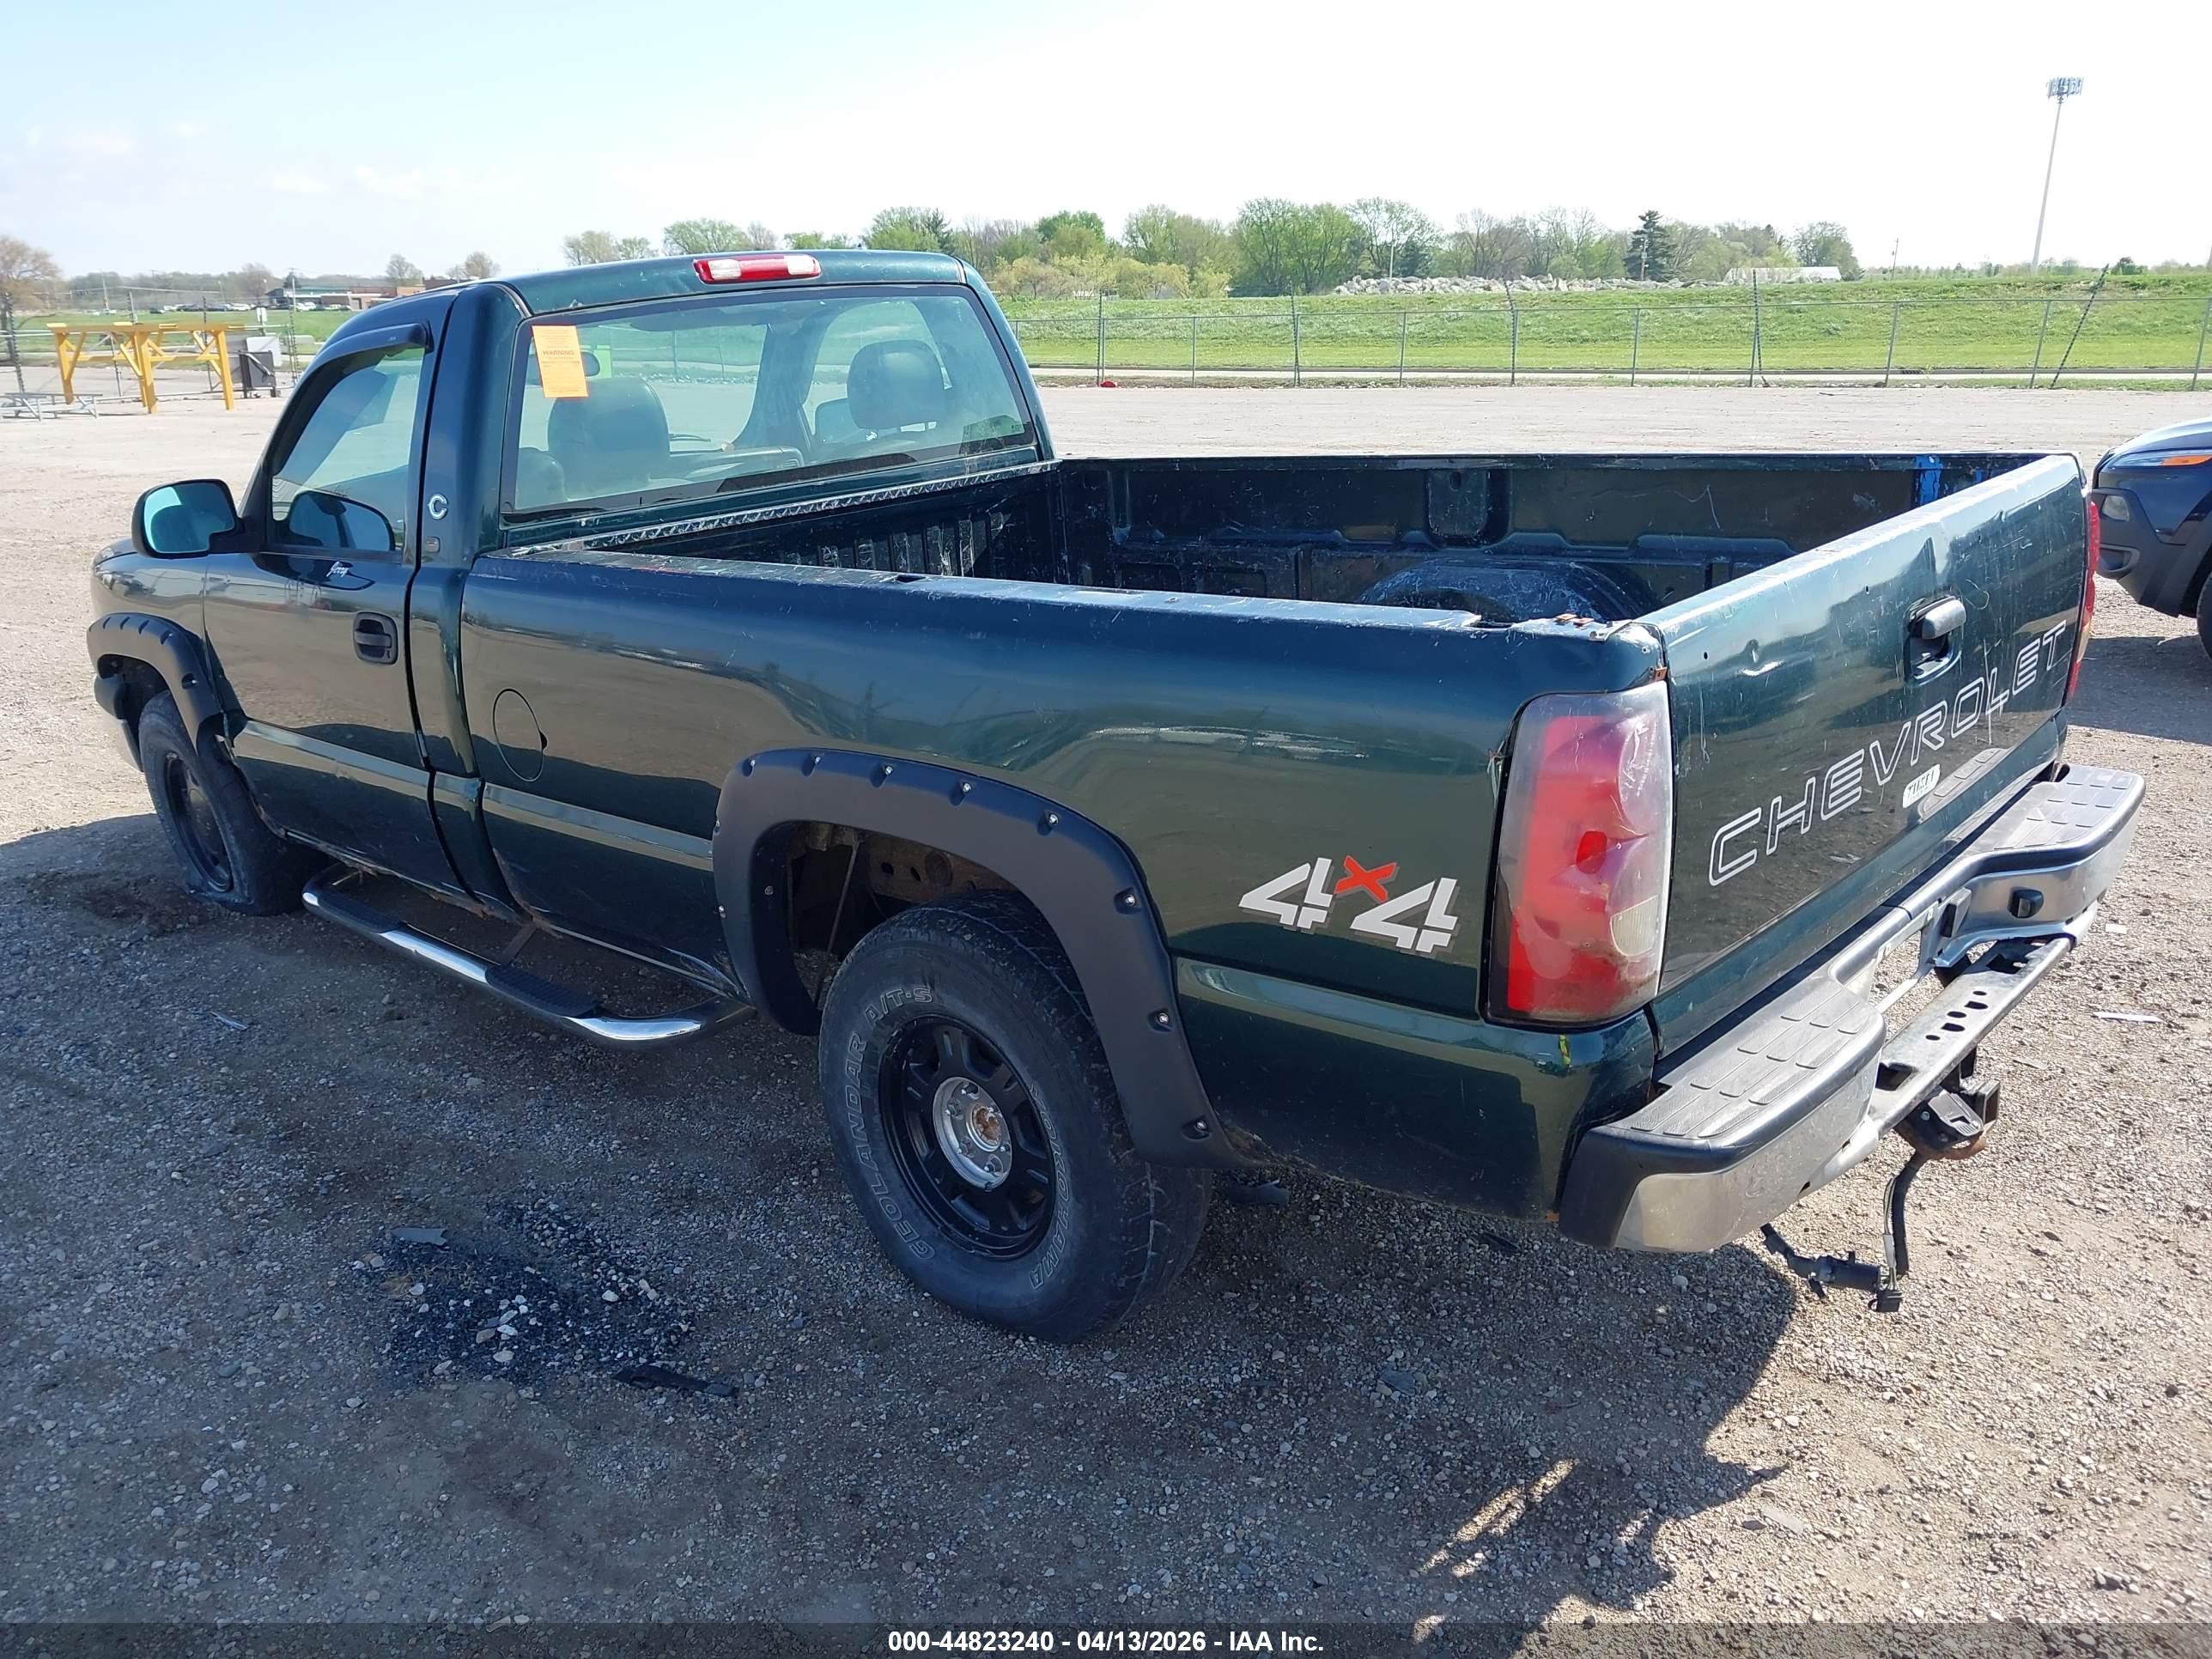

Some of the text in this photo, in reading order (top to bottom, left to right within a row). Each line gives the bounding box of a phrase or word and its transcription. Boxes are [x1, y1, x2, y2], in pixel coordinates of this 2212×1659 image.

[1708, 619, 2067, 886] CHEVROLET
[845, 1032, 936, 1260] GEOLANDAR
[1030, 1083, 1070, 1288] YOKOHAMA
